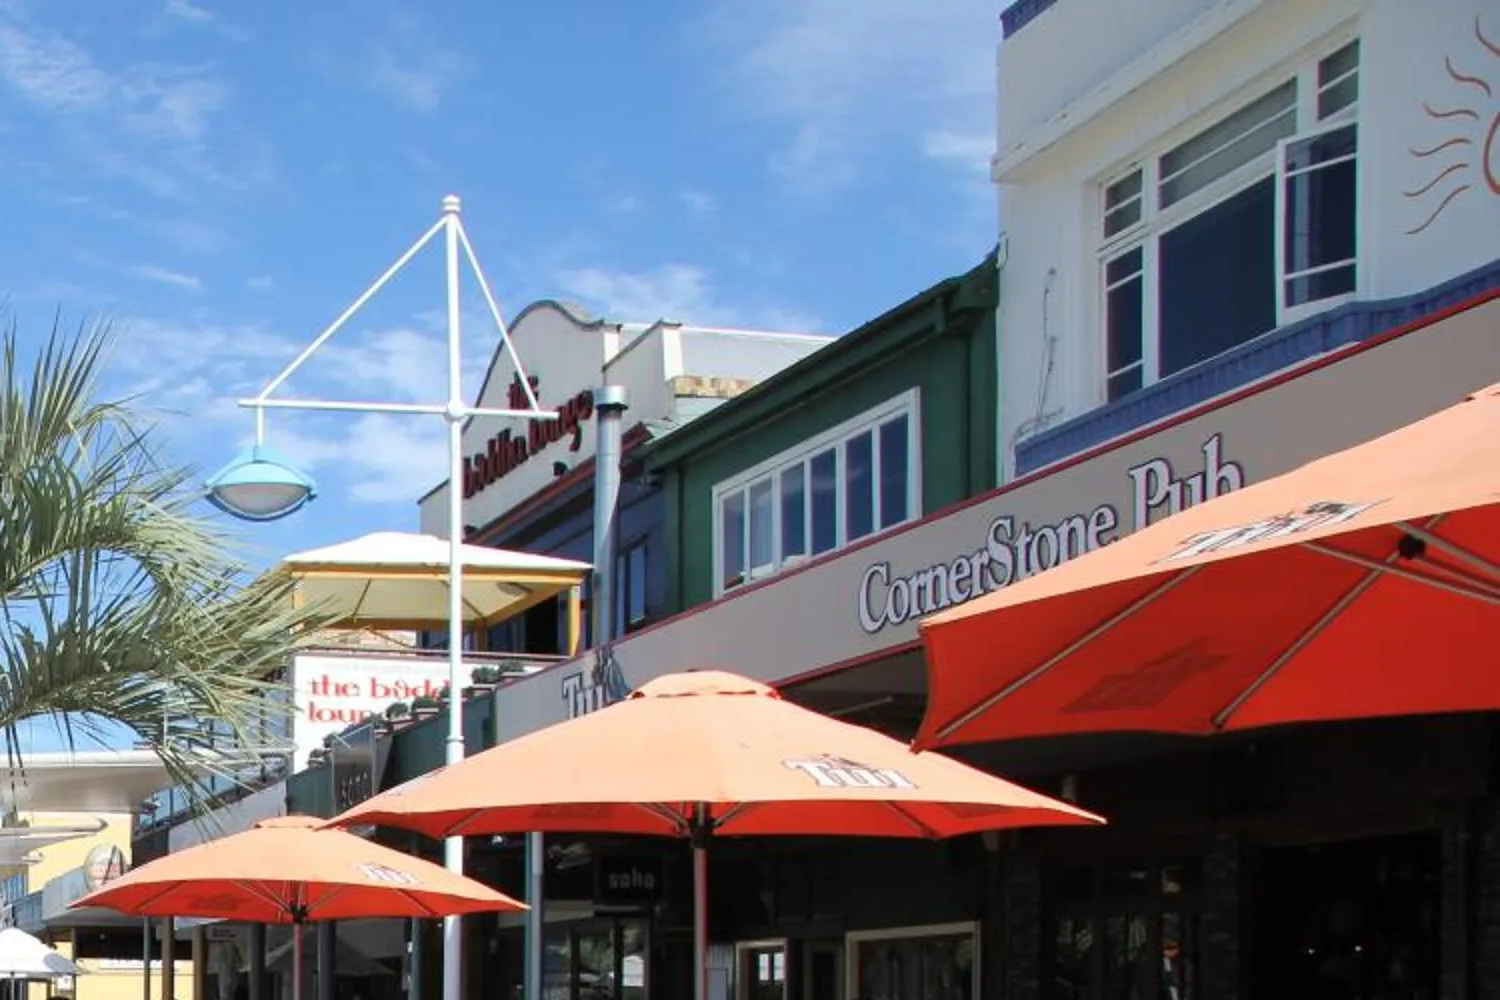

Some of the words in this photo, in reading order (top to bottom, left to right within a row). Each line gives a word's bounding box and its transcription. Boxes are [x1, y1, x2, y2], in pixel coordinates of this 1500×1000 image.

[857, 505, 1119, 634] CornerStone
[1129, 433, 1244, 534] Pub
[309, 674, 360, 698] the
